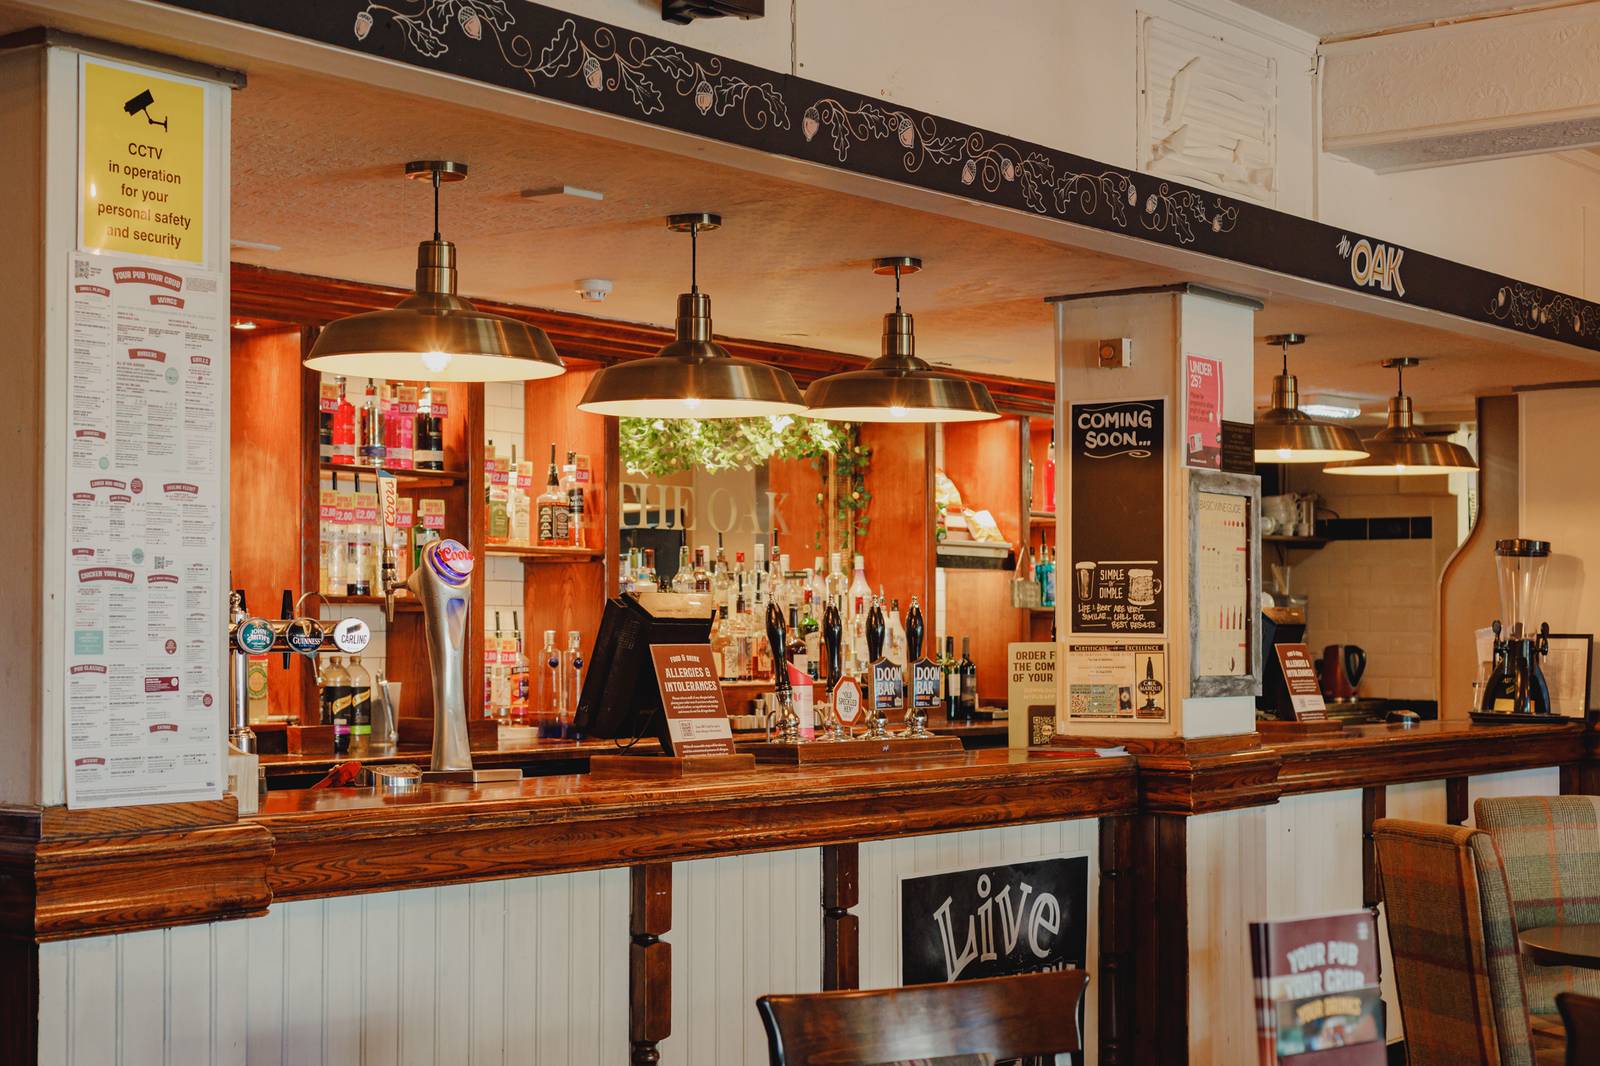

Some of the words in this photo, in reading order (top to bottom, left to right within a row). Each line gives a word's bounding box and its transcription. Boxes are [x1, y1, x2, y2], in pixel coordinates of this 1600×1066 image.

[128, 142, 162, 160] CCTV
[108, 160, 120, 173] in
[123, 165, 181, 184] operation
[121, 183, 138, 197] for
[142, 188, 169, 204] your
[97, 202, 151, 220] personal
[154, 212, 191, 230] safety
[106, 226, 129, 239] and
[133, 231, 181, 249] security
[1351, 239, 1406, 297] OAK
[1189, 360, 1213, 377] UNDER
[1190, 374, 1202, 388] 25?
[1078, 410, 1153, 429] COMING
[1085, 431, 1151, 449] SOON...
[385, 481, 395, 527] Coors
[707, 487, 792, 535] OAK
[441, 549, 474, 562] Coors
[1100, 569, 1125, 580] SIMPLE
[1100, 587, 1123, 599] DIMPLE
[1113, 605, 1126, 613] ARE
[1111, 621, 1128, 629] BEST
[292, 636, 321, 645] GUINNESS
[341, 634, 368, 645] CARLING
[1016, 651, 1046, 660] ORDER
[665, 667, 704, 678] ALLERGIES
[704, 667, 711, 677] &
[1013, 662, 1031, 671] THE
[1034, 662, 1055, 671] COM
[1013, 673, 1024, 682] OF
[1028, 673, 1053, 682] YOUR
[664, 681, 717, 692] INTOLERANCES
[878, 681, 895, 695] BAR
[917, 680, 934, 695] BAR
[933, 873, 1061, 984] Live
